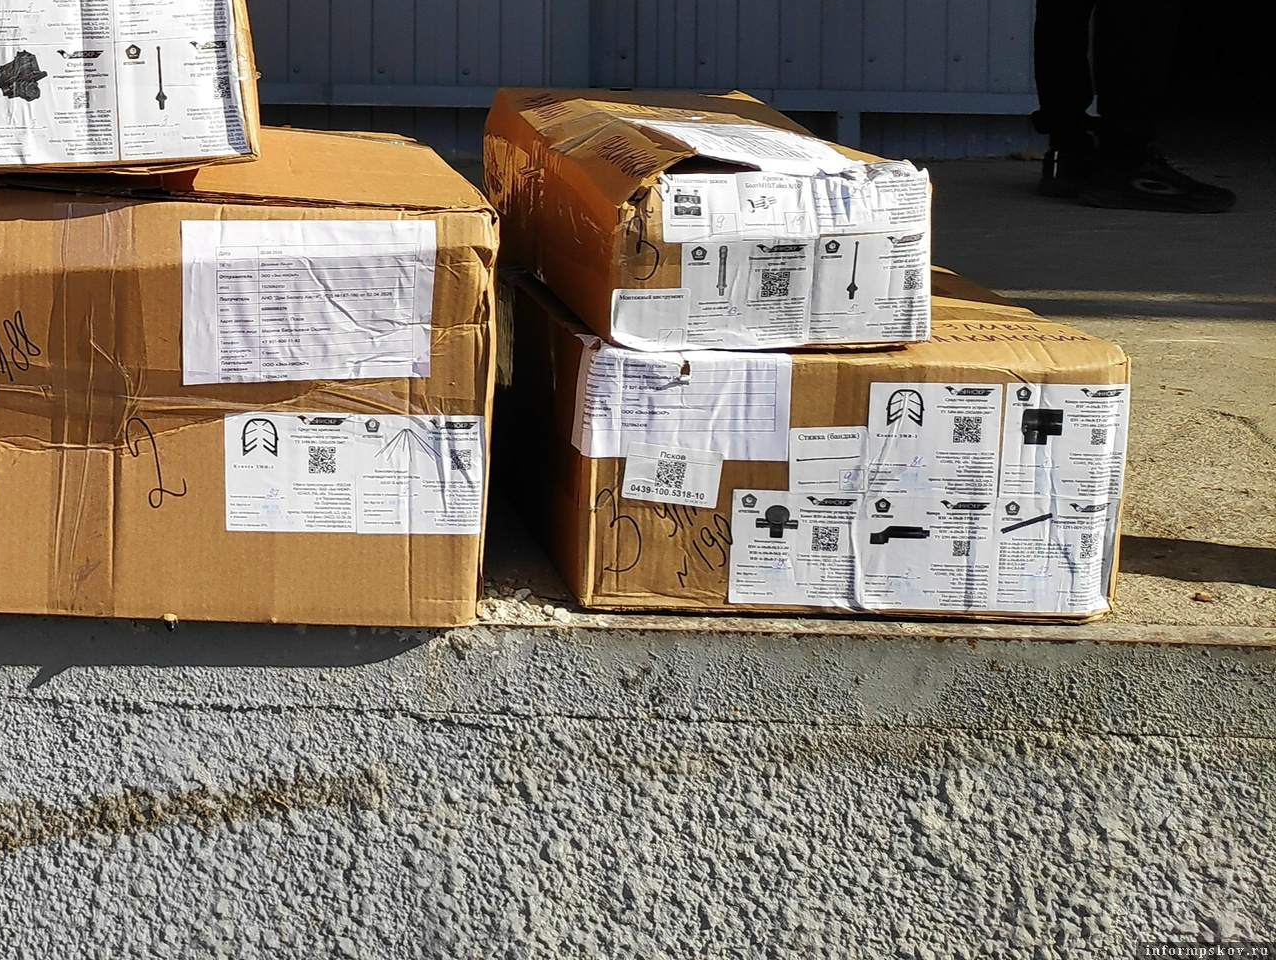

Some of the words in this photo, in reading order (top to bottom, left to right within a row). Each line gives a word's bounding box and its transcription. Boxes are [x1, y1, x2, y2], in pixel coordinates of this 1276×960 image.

[660, 451, 687, 461] Псков
[630, 484, 705, 501] 0439-100.5318-10
[594, 488, 642, 572] 3
